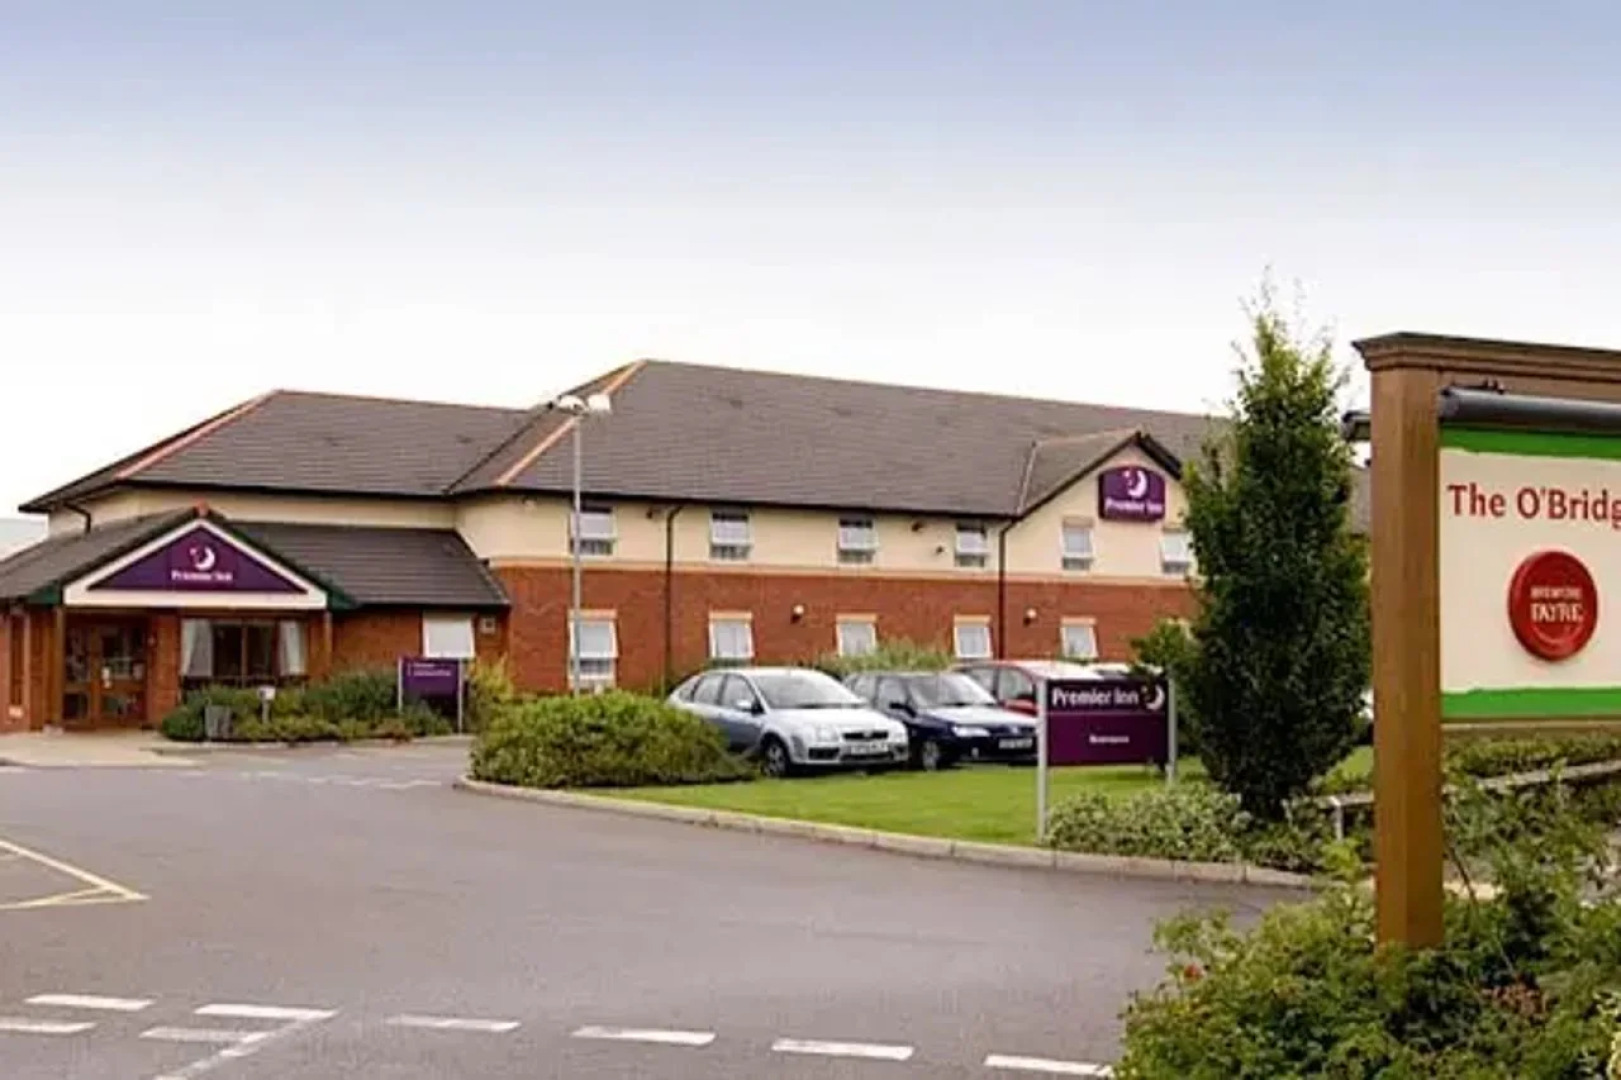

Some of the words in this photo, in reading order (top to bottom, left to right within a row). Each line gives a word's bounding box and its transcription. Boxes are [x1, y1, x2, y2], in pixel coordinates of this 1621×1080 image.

[1446, 482, 1506, 517] The
[1052, 687, 1112, 706] Premier
[1114, 687, 1139, 704] Inn
